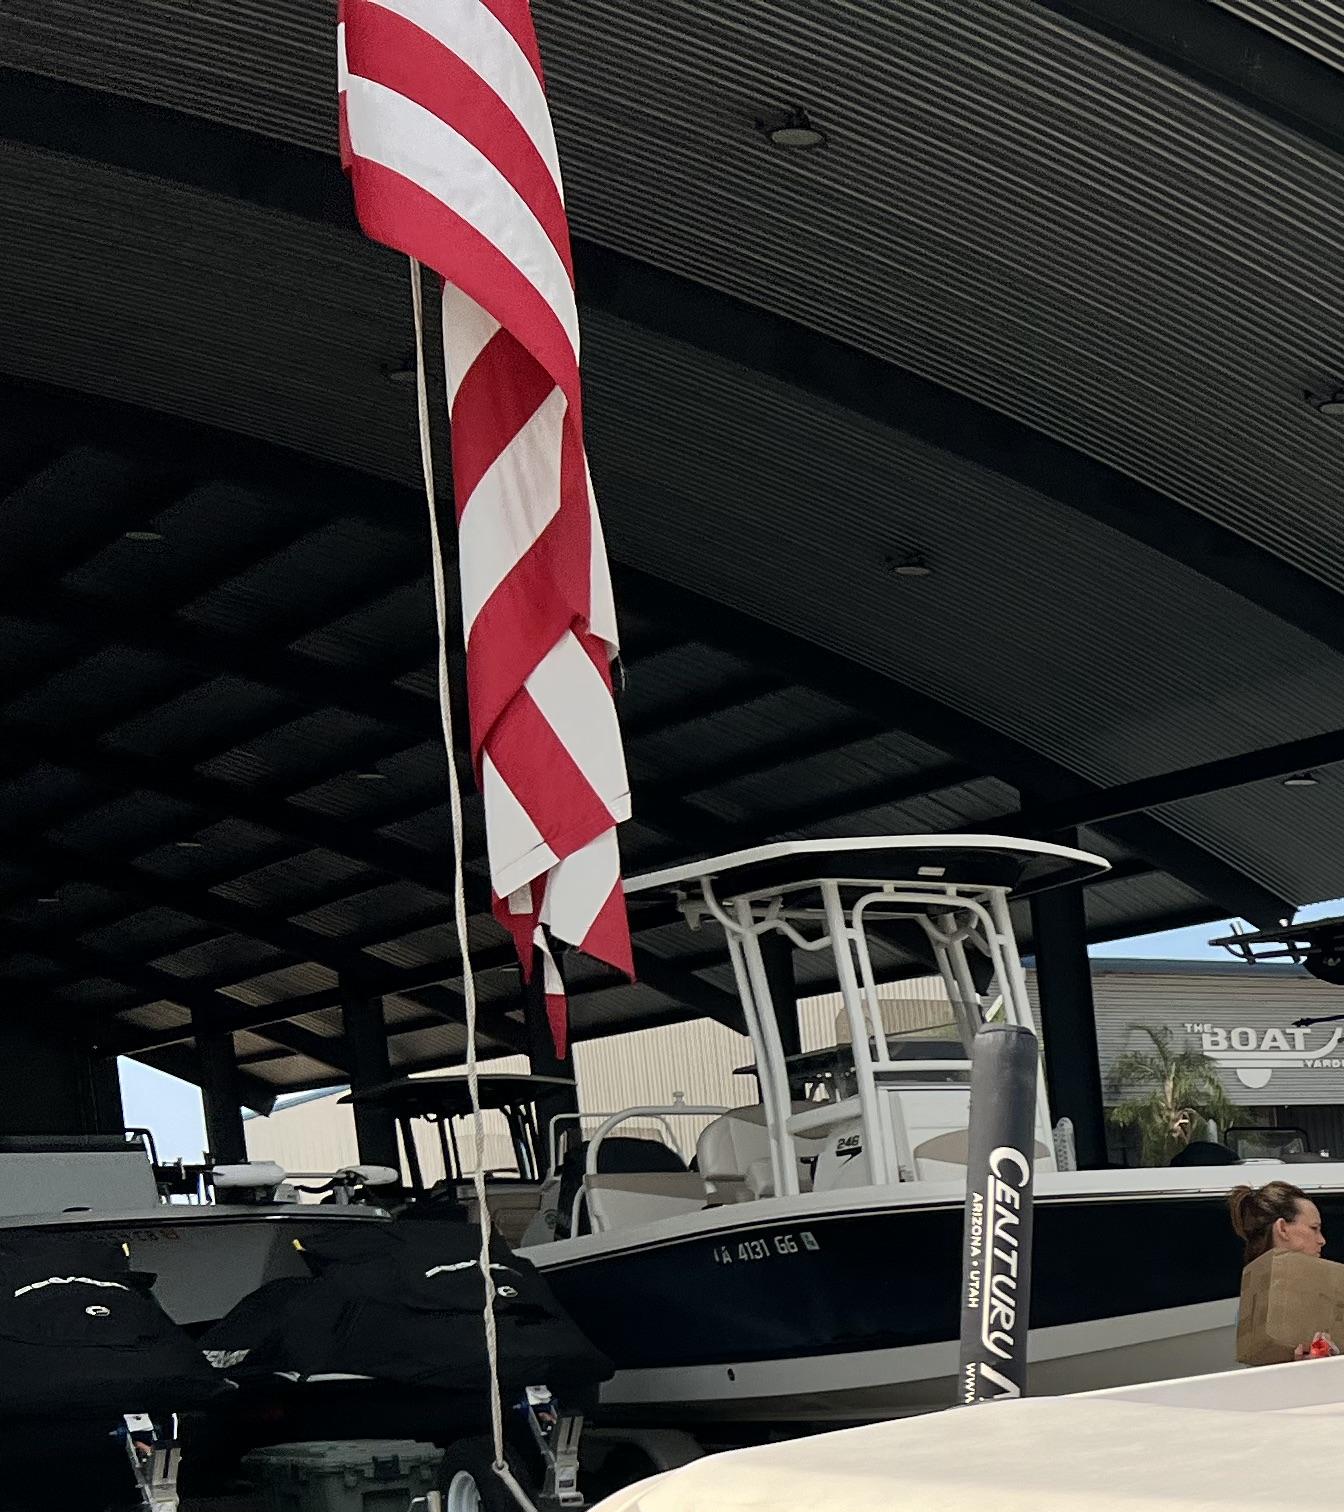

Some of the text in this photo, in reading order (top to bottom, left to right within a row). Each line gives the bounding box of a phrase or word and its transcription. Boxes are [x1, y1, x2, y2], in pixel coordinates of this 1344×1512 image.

[1184, 1023, 1212, 1033] THE
[1202, 1027, 1312, 1051] BOAT
[1305, 1058, 1342, 1068] YARD
[738, 1239, 770, 1261] 4131
[967, 1191, 984, 1308] ARIZONA UTAH
[988, 1146, 1031, 1360] CENTURY
